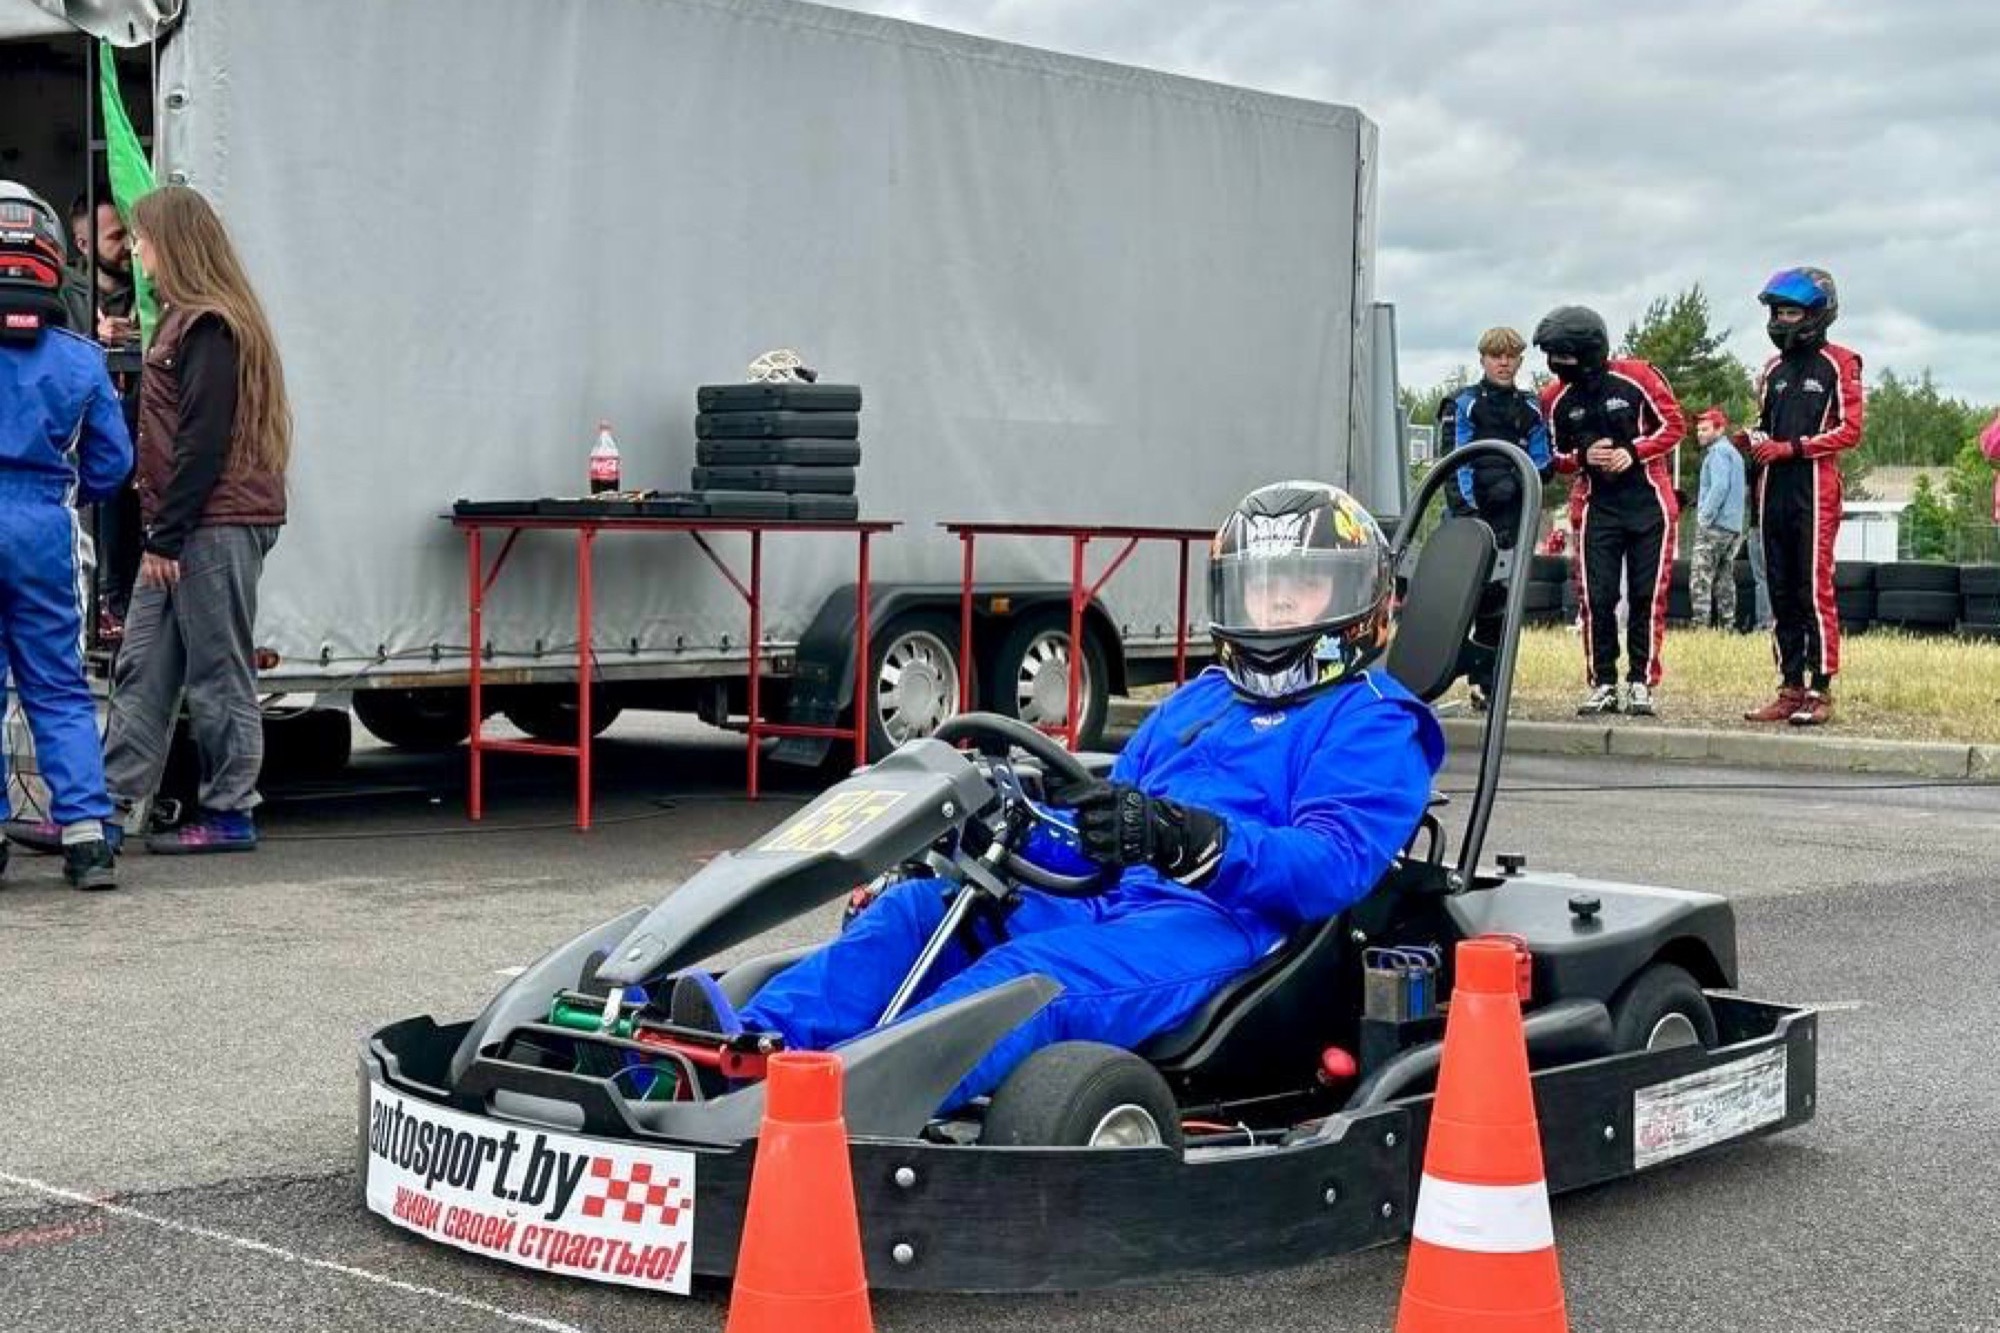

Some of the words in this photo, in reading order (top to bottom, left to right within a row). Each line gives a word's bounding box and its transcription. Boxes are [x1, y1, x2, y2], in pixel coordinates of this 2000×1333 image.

[371, 1098, 589, 1222] autosport.by
[443, 1205, 519, 1253] своей
[518, 1223, 688, 1283] страстью!
